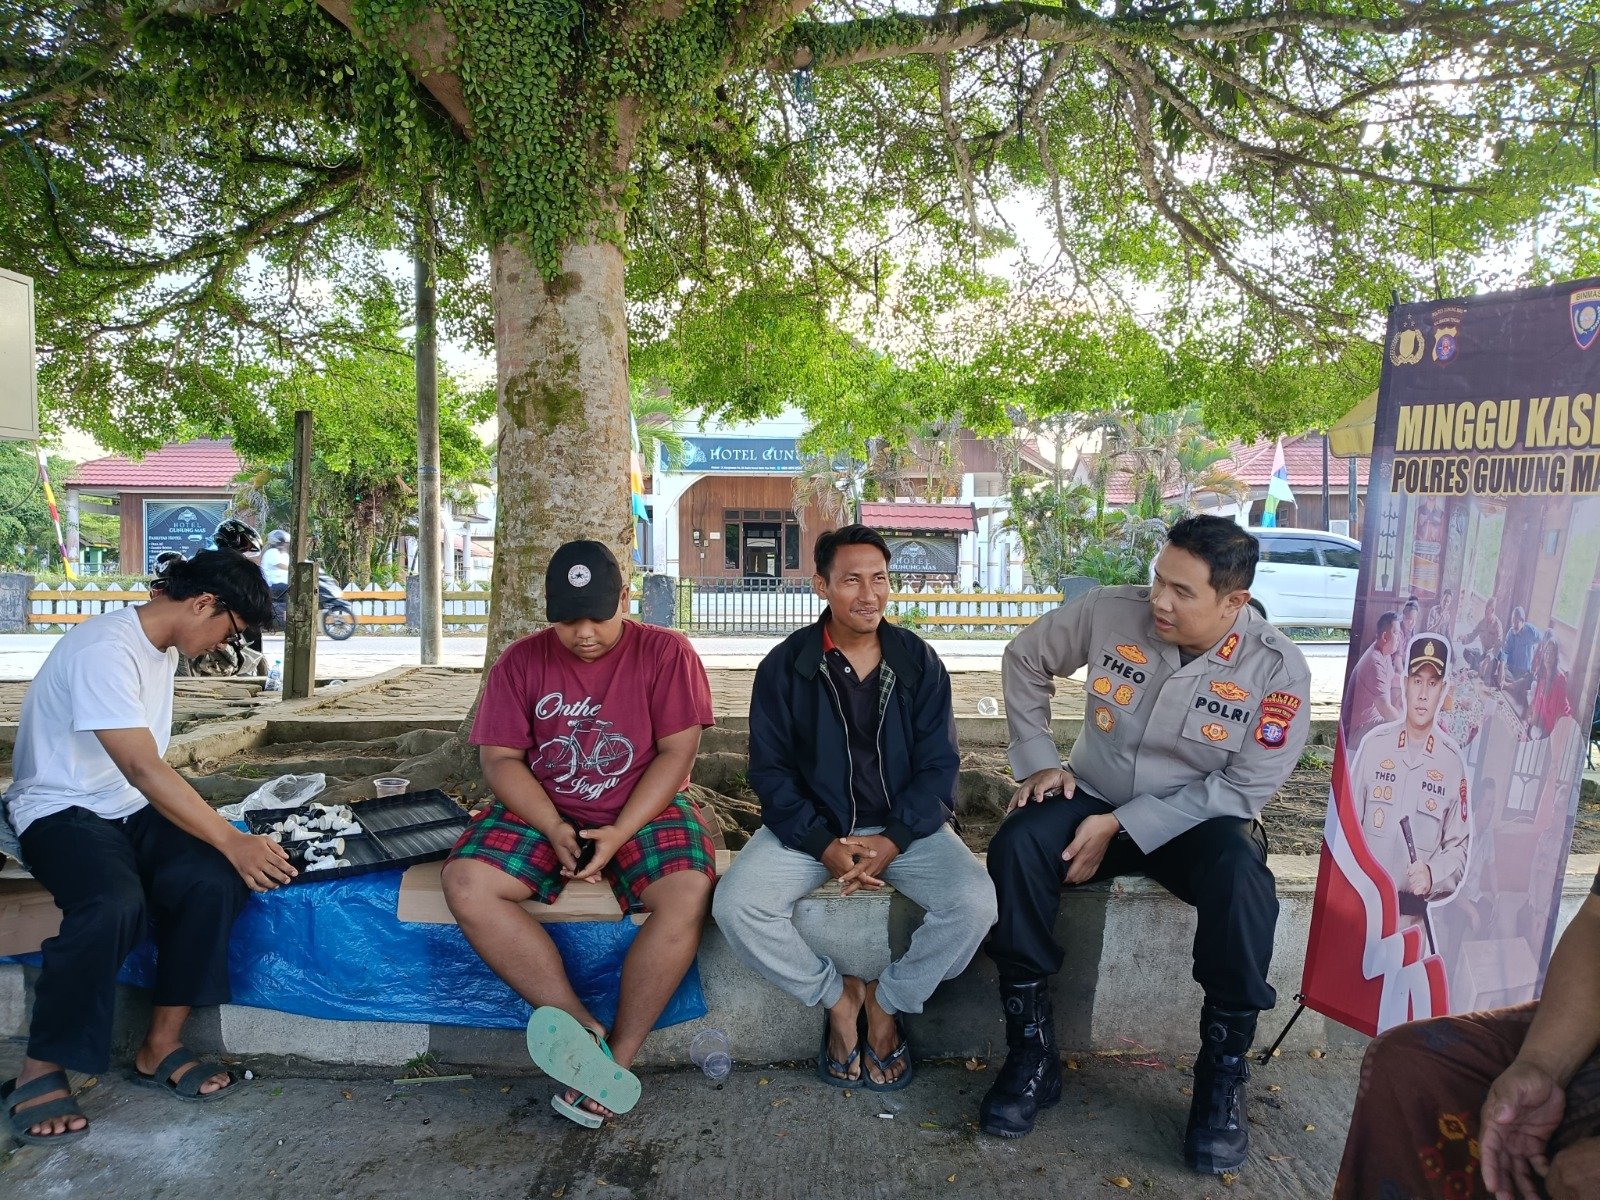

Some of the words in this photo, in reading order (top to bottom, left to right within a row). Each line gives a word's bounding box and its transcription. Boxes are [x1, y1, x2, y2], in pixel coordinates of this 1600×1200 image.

[1395, 400, 1521, 451] MINGGU
[710, 446, 757, 460] HOTEL
[762, 446, 815, 461] GUN
[1391, 456, 1470, 495] POLRES
[1473, 454, 1566, 495] GUNUNG
[896, 557, 931, 565] HOTEL
[1102, 654, 1146, 684] THEO
[1195, 696, 1250, 724] POLRI
[1375, 771, 1396, 783] THEO
[1421, 781, 1446, 796] POLRI
